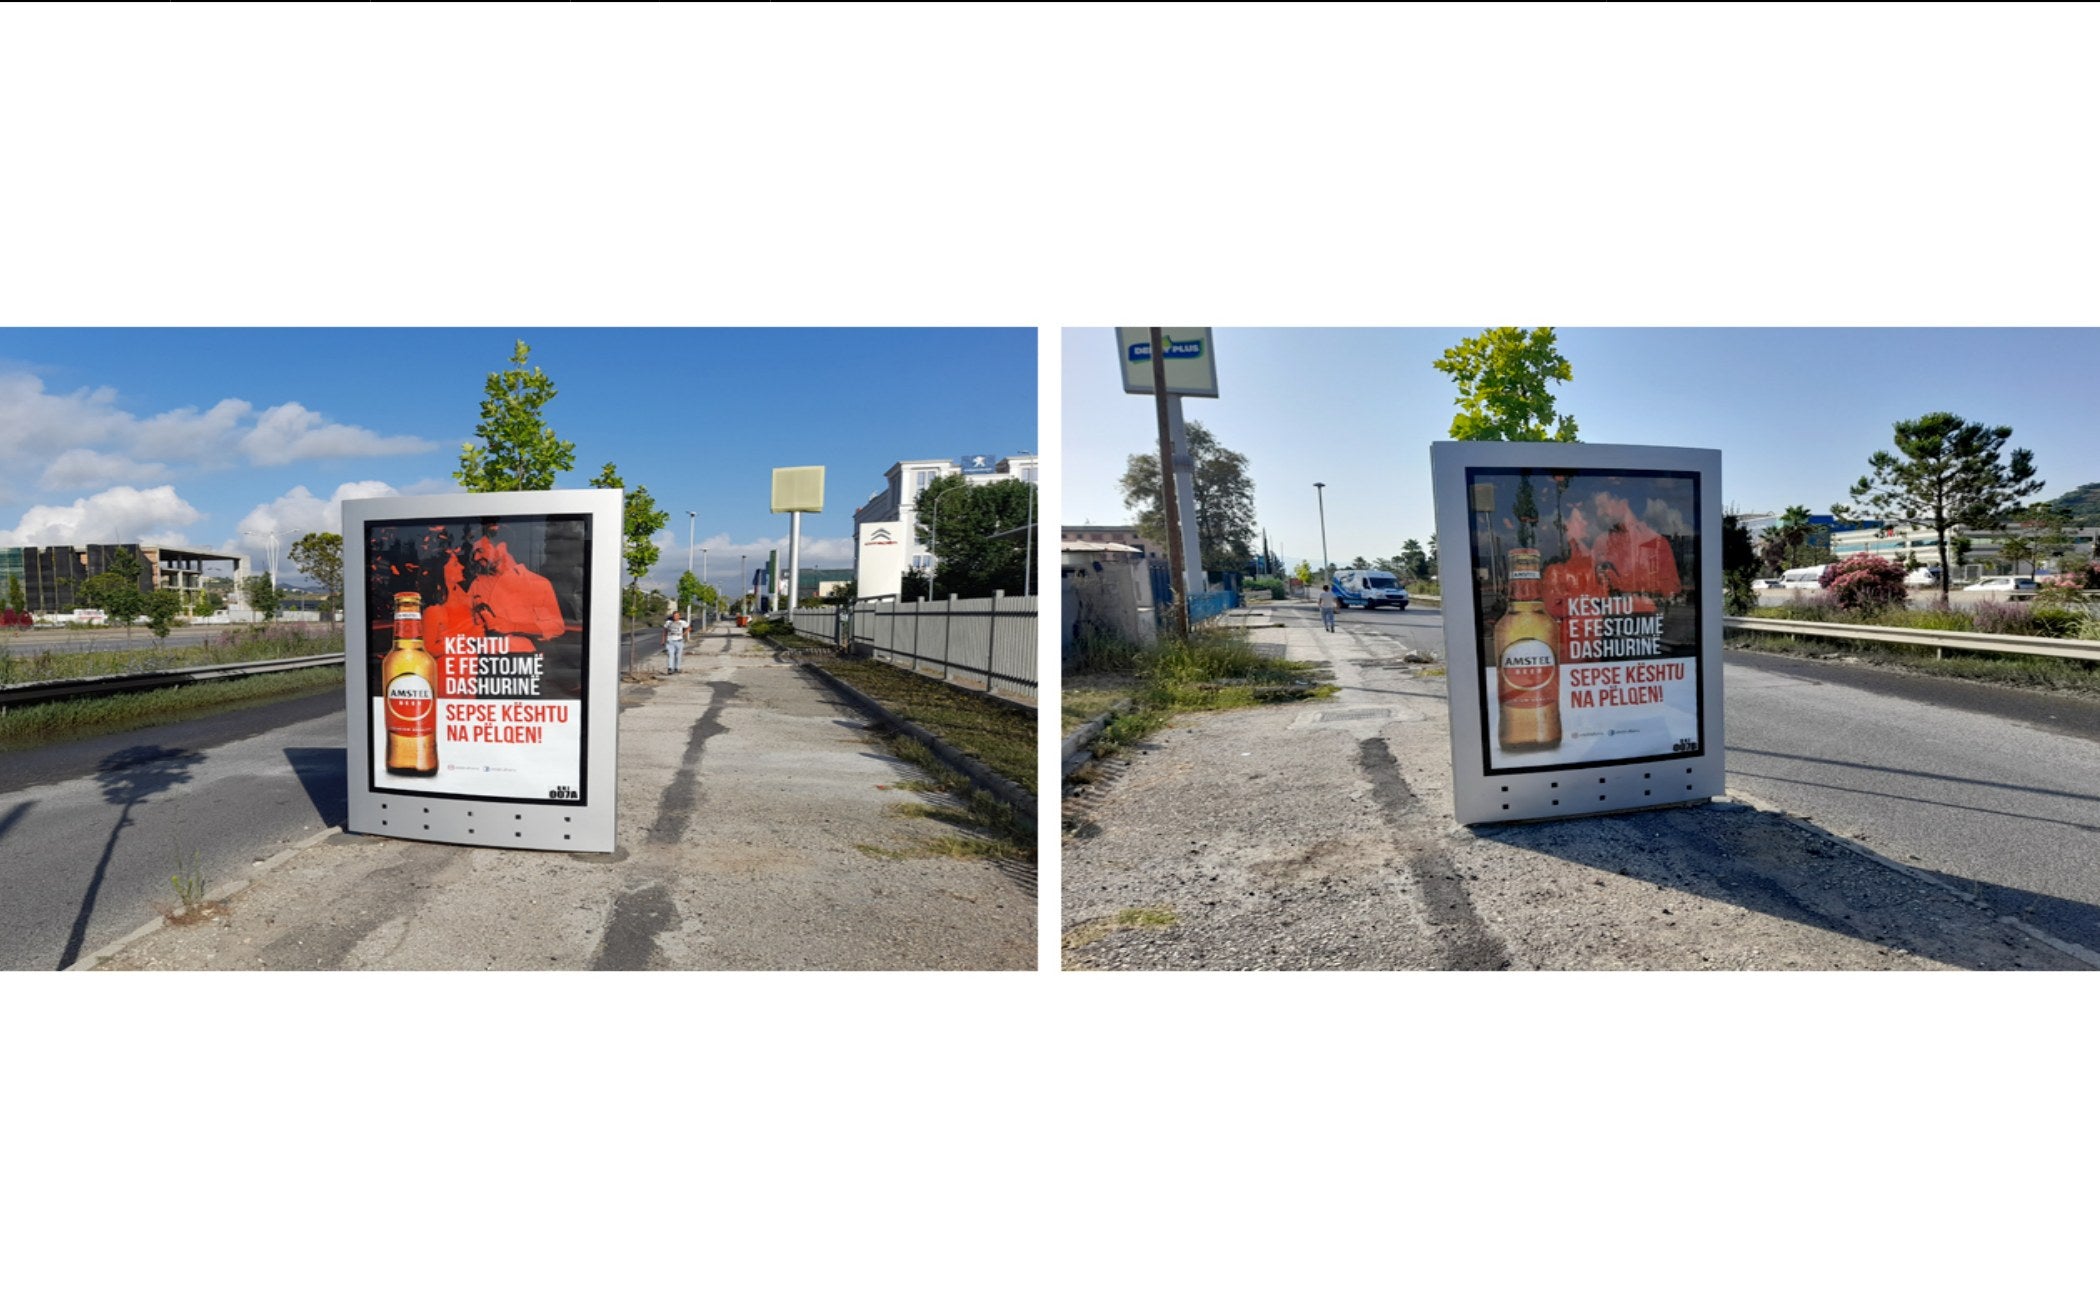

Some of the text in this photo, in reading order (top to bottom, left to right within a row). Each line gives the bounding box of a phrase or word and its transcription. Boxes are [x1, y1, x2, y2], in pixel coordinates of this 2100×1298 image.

[1172, 344, 1199, 353] PLUS
[1568, 594, 1634, 617] KËSHTU
[1569, 613, 1664, 638] E FESTOJMË
[444, 634, 510, 655] KËSHTU
[1570, 634, 1662, 659] DASHURINË
[445, 653, 544, 675] E FESTOJMË
[1505, 656, 1551, 666] AMSTEL
[445, 674, 540, 696] DASHURINË
[1570, 662, 1685, 687] SEPSE KËSHTU
[390, 688, 429, 698] AMSTEL
[1571, 685, 1664, 708] NA PËLQEN!
[446, 702, 569, 723] SEPSE KËSHTU
[447, 722, 543, 744] NA PËLQEN!
